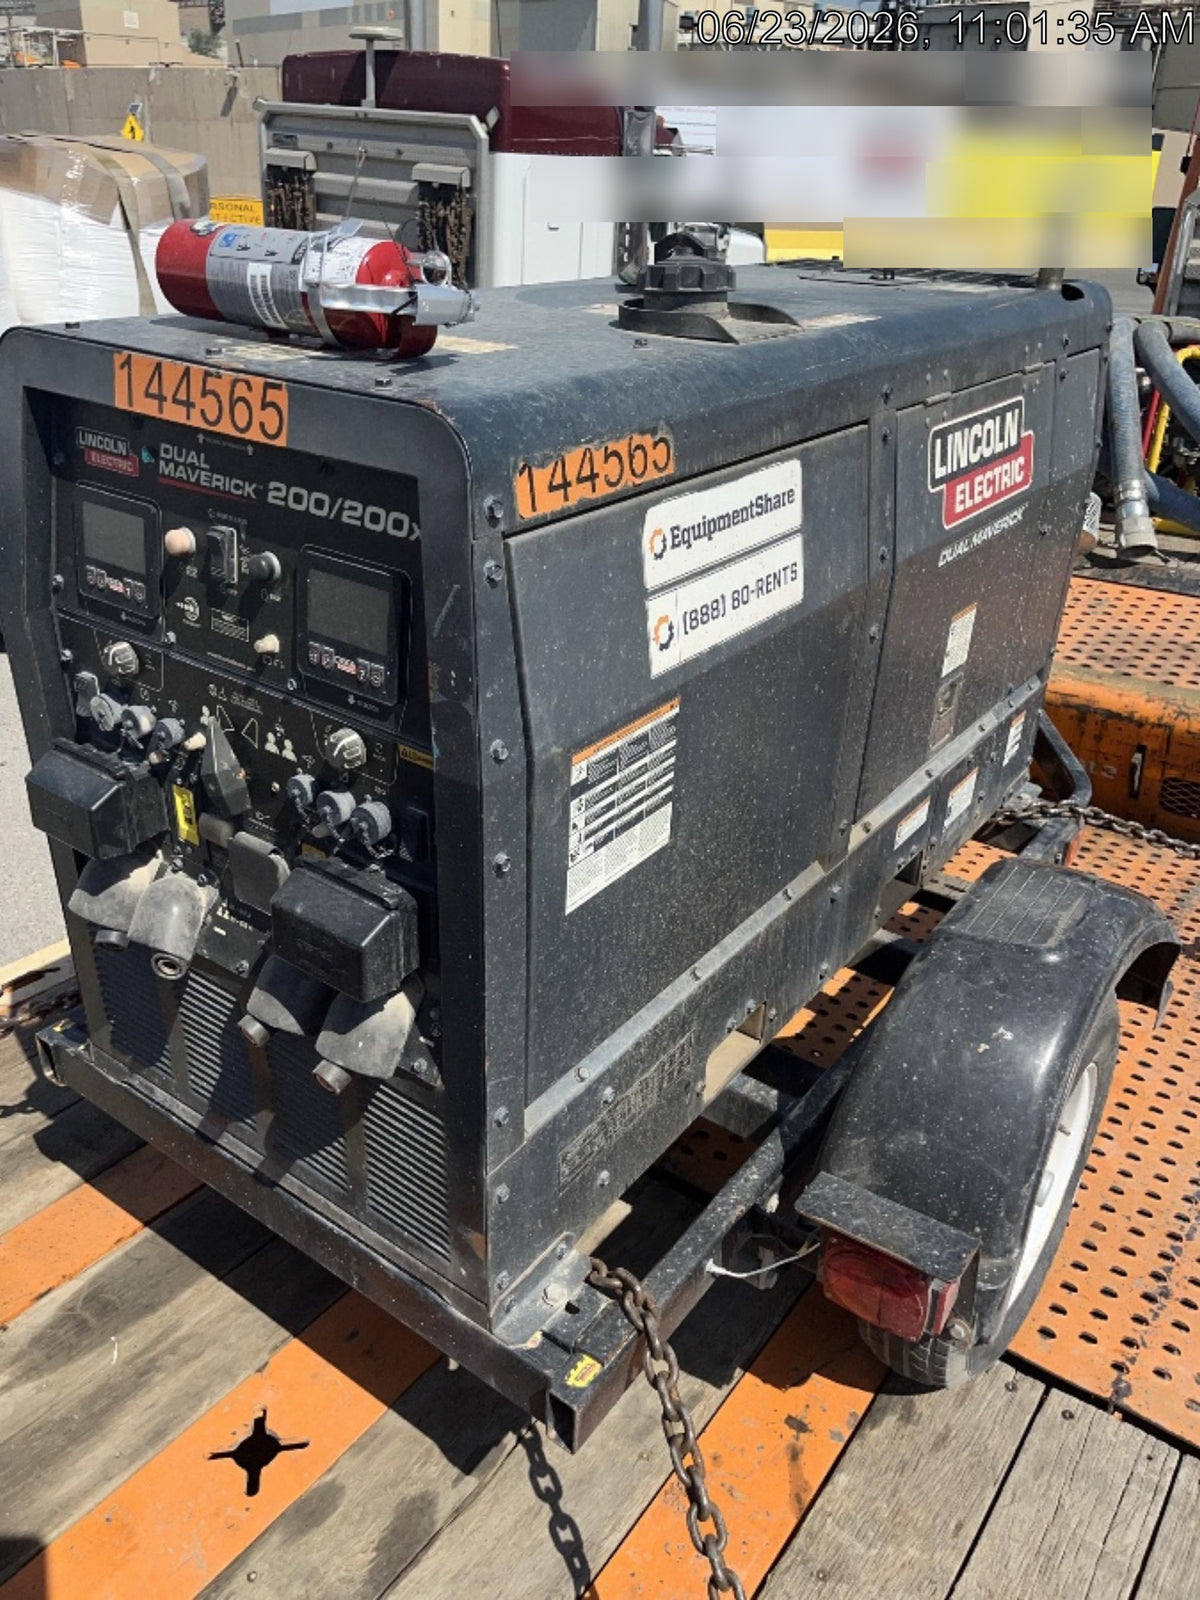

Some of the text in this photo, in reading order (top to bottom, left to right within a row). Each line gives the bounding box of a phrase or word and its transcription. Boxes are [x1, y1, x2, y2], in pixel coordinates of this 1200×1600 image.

[119, 357, 286, 441] 144565
[79, 431, 127, 456] LINCOLN
[91, 452, 134, 472] ELECTRIC
[159, 443, 211, 469] DUAL
[934, 408, 1021, 479] LINCOLN
[159, 462, 258, 500] MAVERICK
[518, 435, 672, 512] 144565
[954, 456, 1025, 514] ELECTRIC
[669, 486, 796, 551] EquipmentShare
[938, 539, 970, 567] DUAL
[682, 593, 727, 636] (888)
